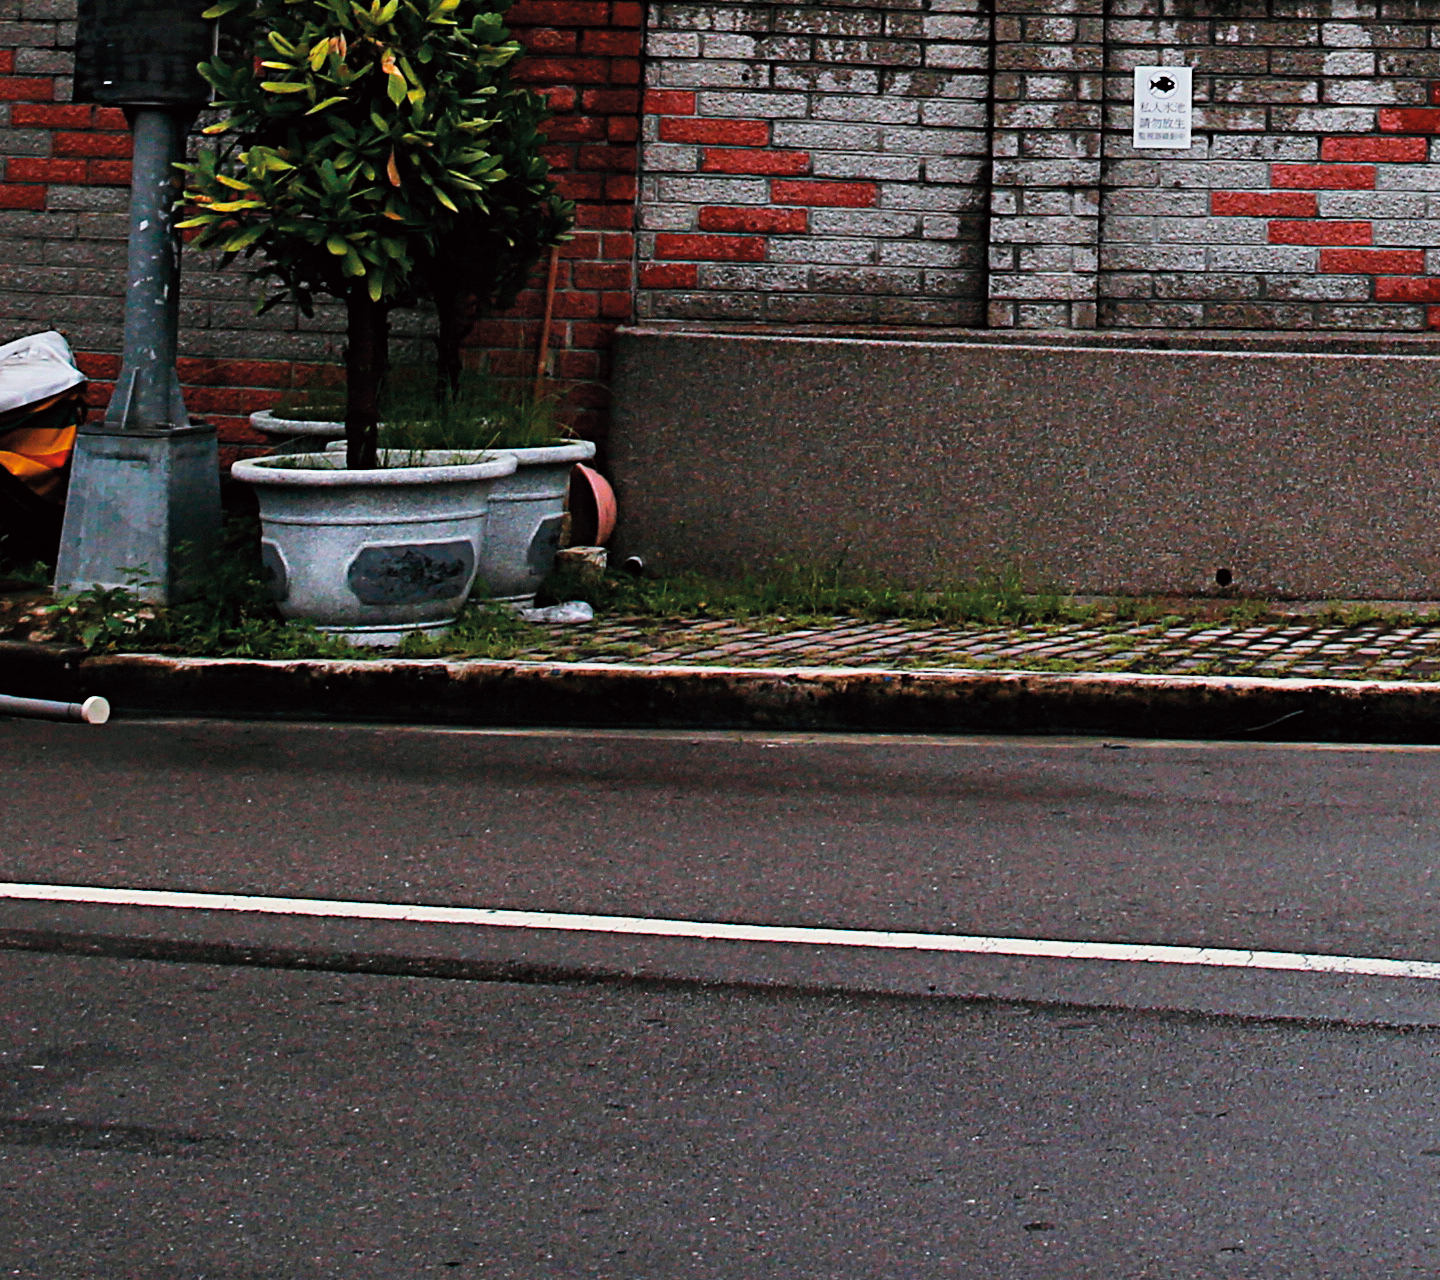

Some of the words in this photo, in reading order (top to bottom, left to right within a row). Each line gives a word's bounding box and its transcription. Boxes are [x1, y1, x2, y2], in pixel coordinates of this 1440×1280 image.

[1140, 101, 1186, 114] 私人水池
[1139, 117, 1186, 129] 請勿放生
